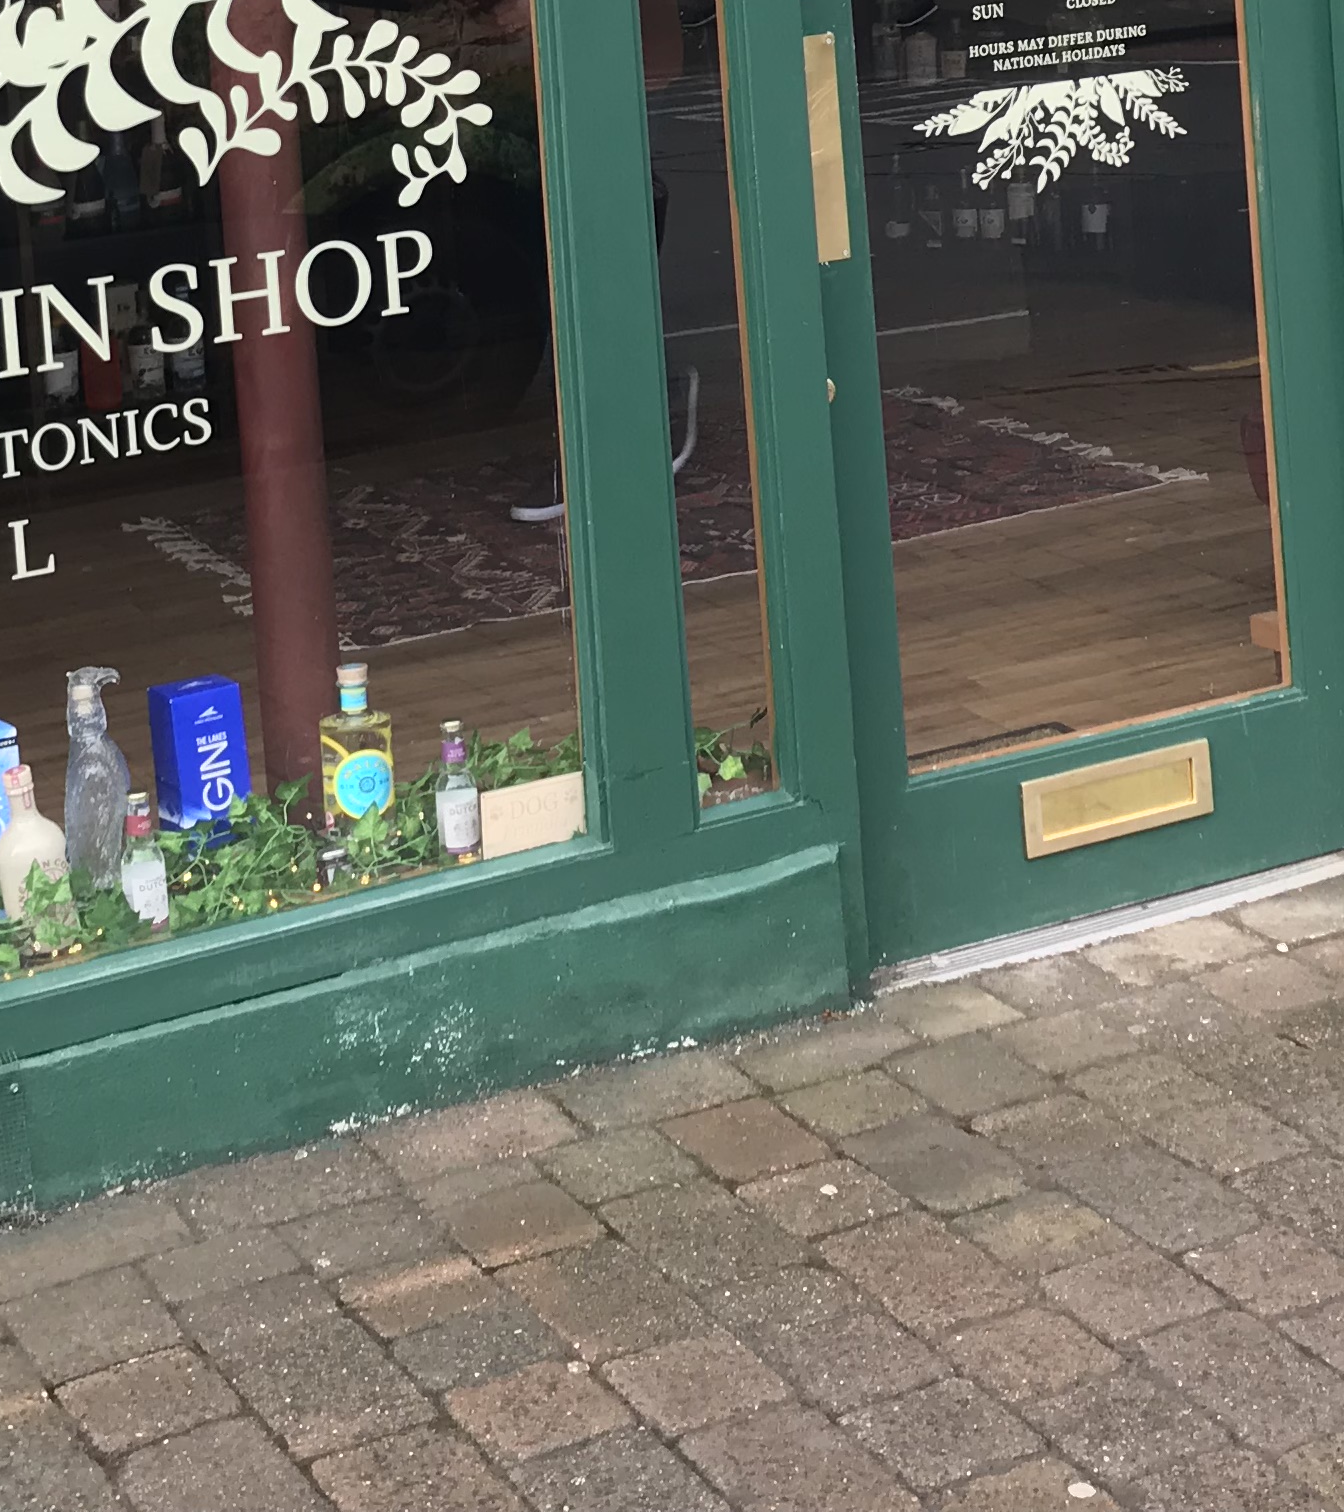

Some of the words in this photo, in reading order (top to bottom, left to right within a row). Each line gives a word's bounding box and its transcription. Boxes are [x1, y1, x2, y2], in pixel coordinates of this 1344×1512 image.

[972, 3, 1004, 21] SUN
[969, 41, 1014, 58] HOURS
[1017, 37, 1046, 52] MAY
[1048, 31, 1093, 48] DIFFER
[1096, 24, 1147, 42] DURING
[993, 52, 1059, 72] NATIONAL
[1062, 43, 1126, 63] HOLIDAYS
[148, 228, 433, 355] SHOP
[197, 740, 234, 811] GIN
[511, 791, 559, 819] DOG
